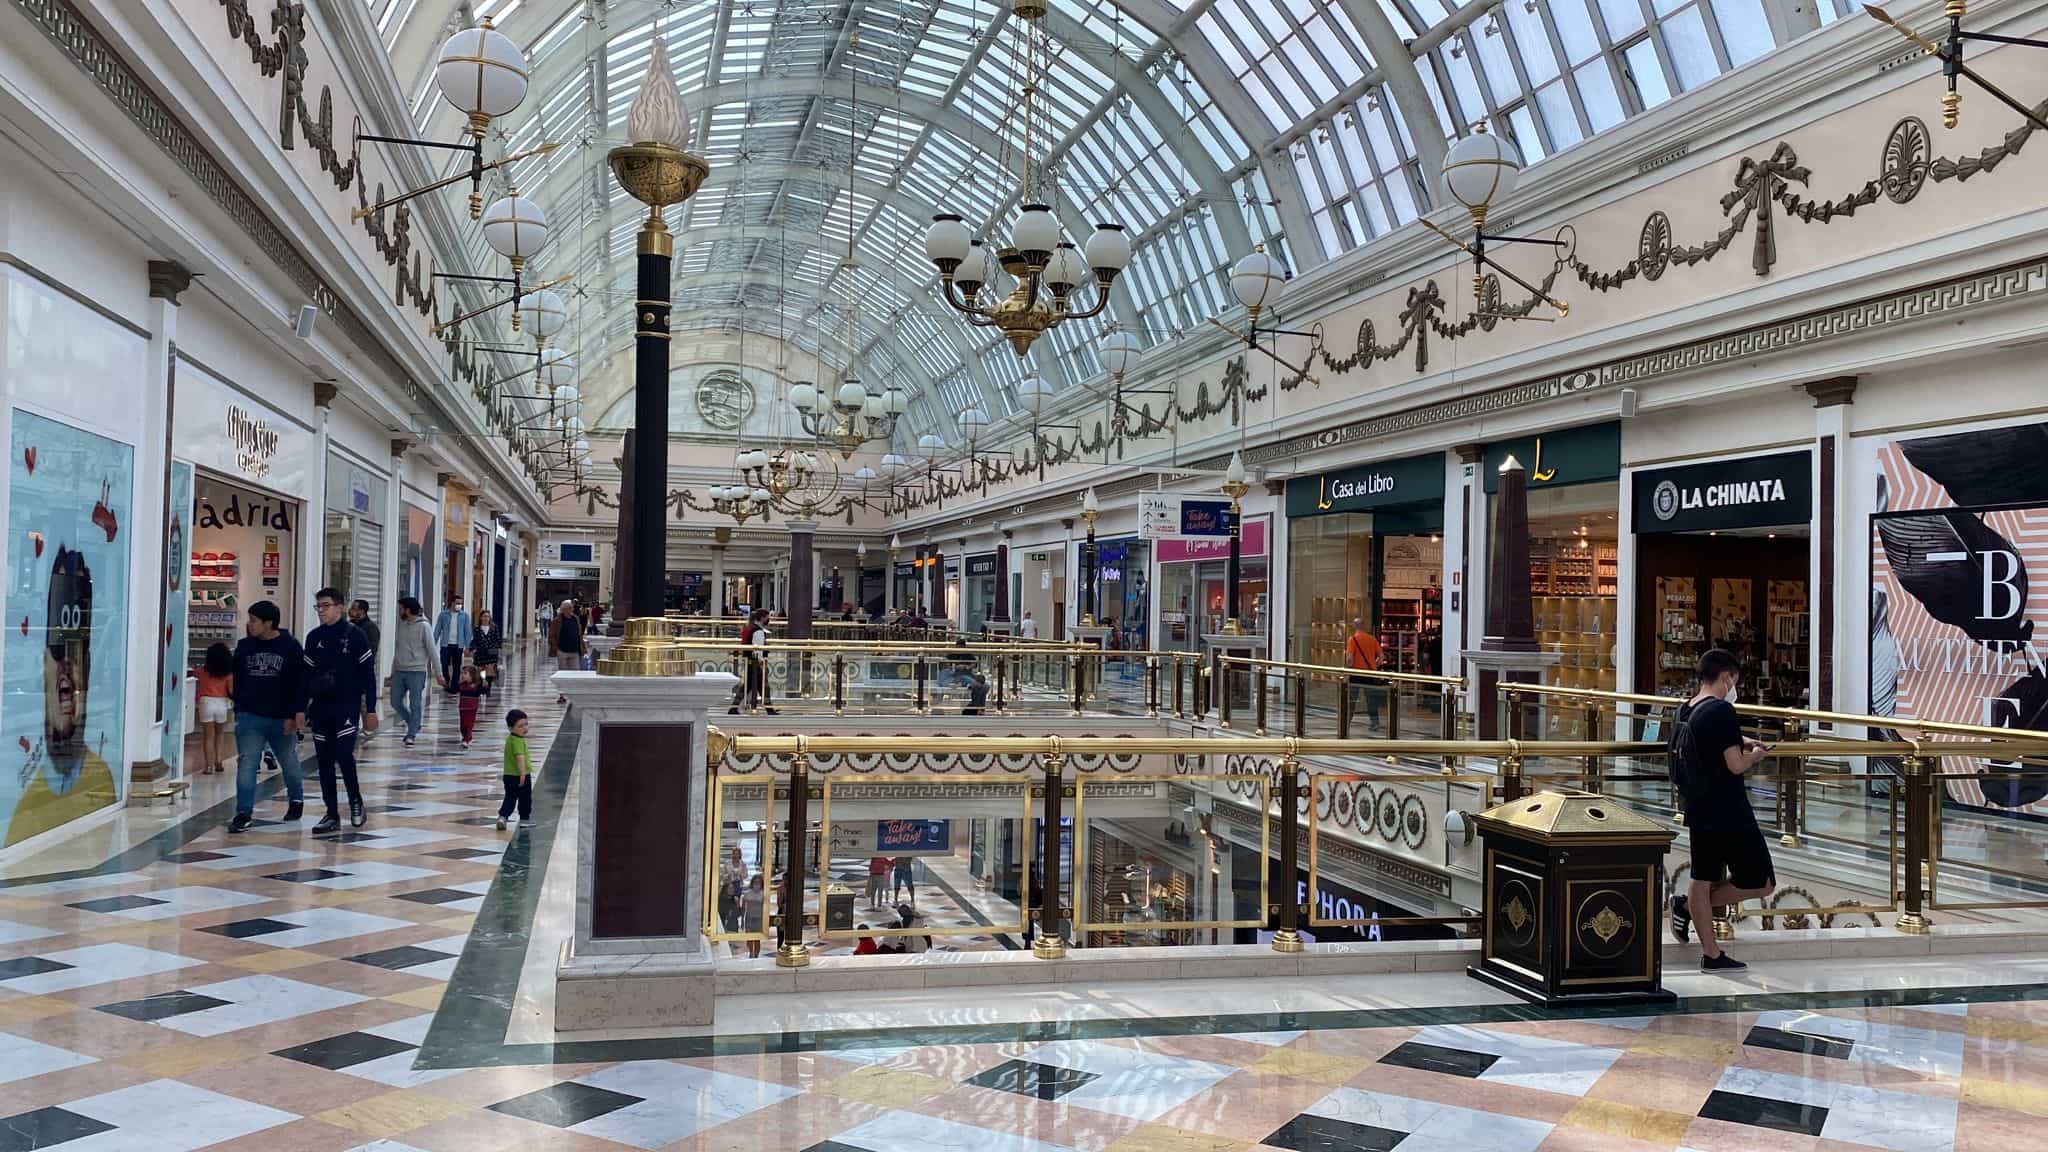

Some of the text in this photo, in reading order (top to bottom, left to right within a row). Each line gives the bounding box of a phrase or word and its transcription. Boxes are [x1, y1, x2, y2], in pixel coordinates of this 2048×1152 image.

[1332, 479, 1354, 498] Casa
[1355, 479, 1367, 496] del
[1368, 472, 1394, 494] Libro
[1681, 487, 1704, 509] LA
[1706, 479, 1786, 507] CHINATA
[881, 819, 915, 834] Take
[1297, 880, 1382, 943] EPHORA
